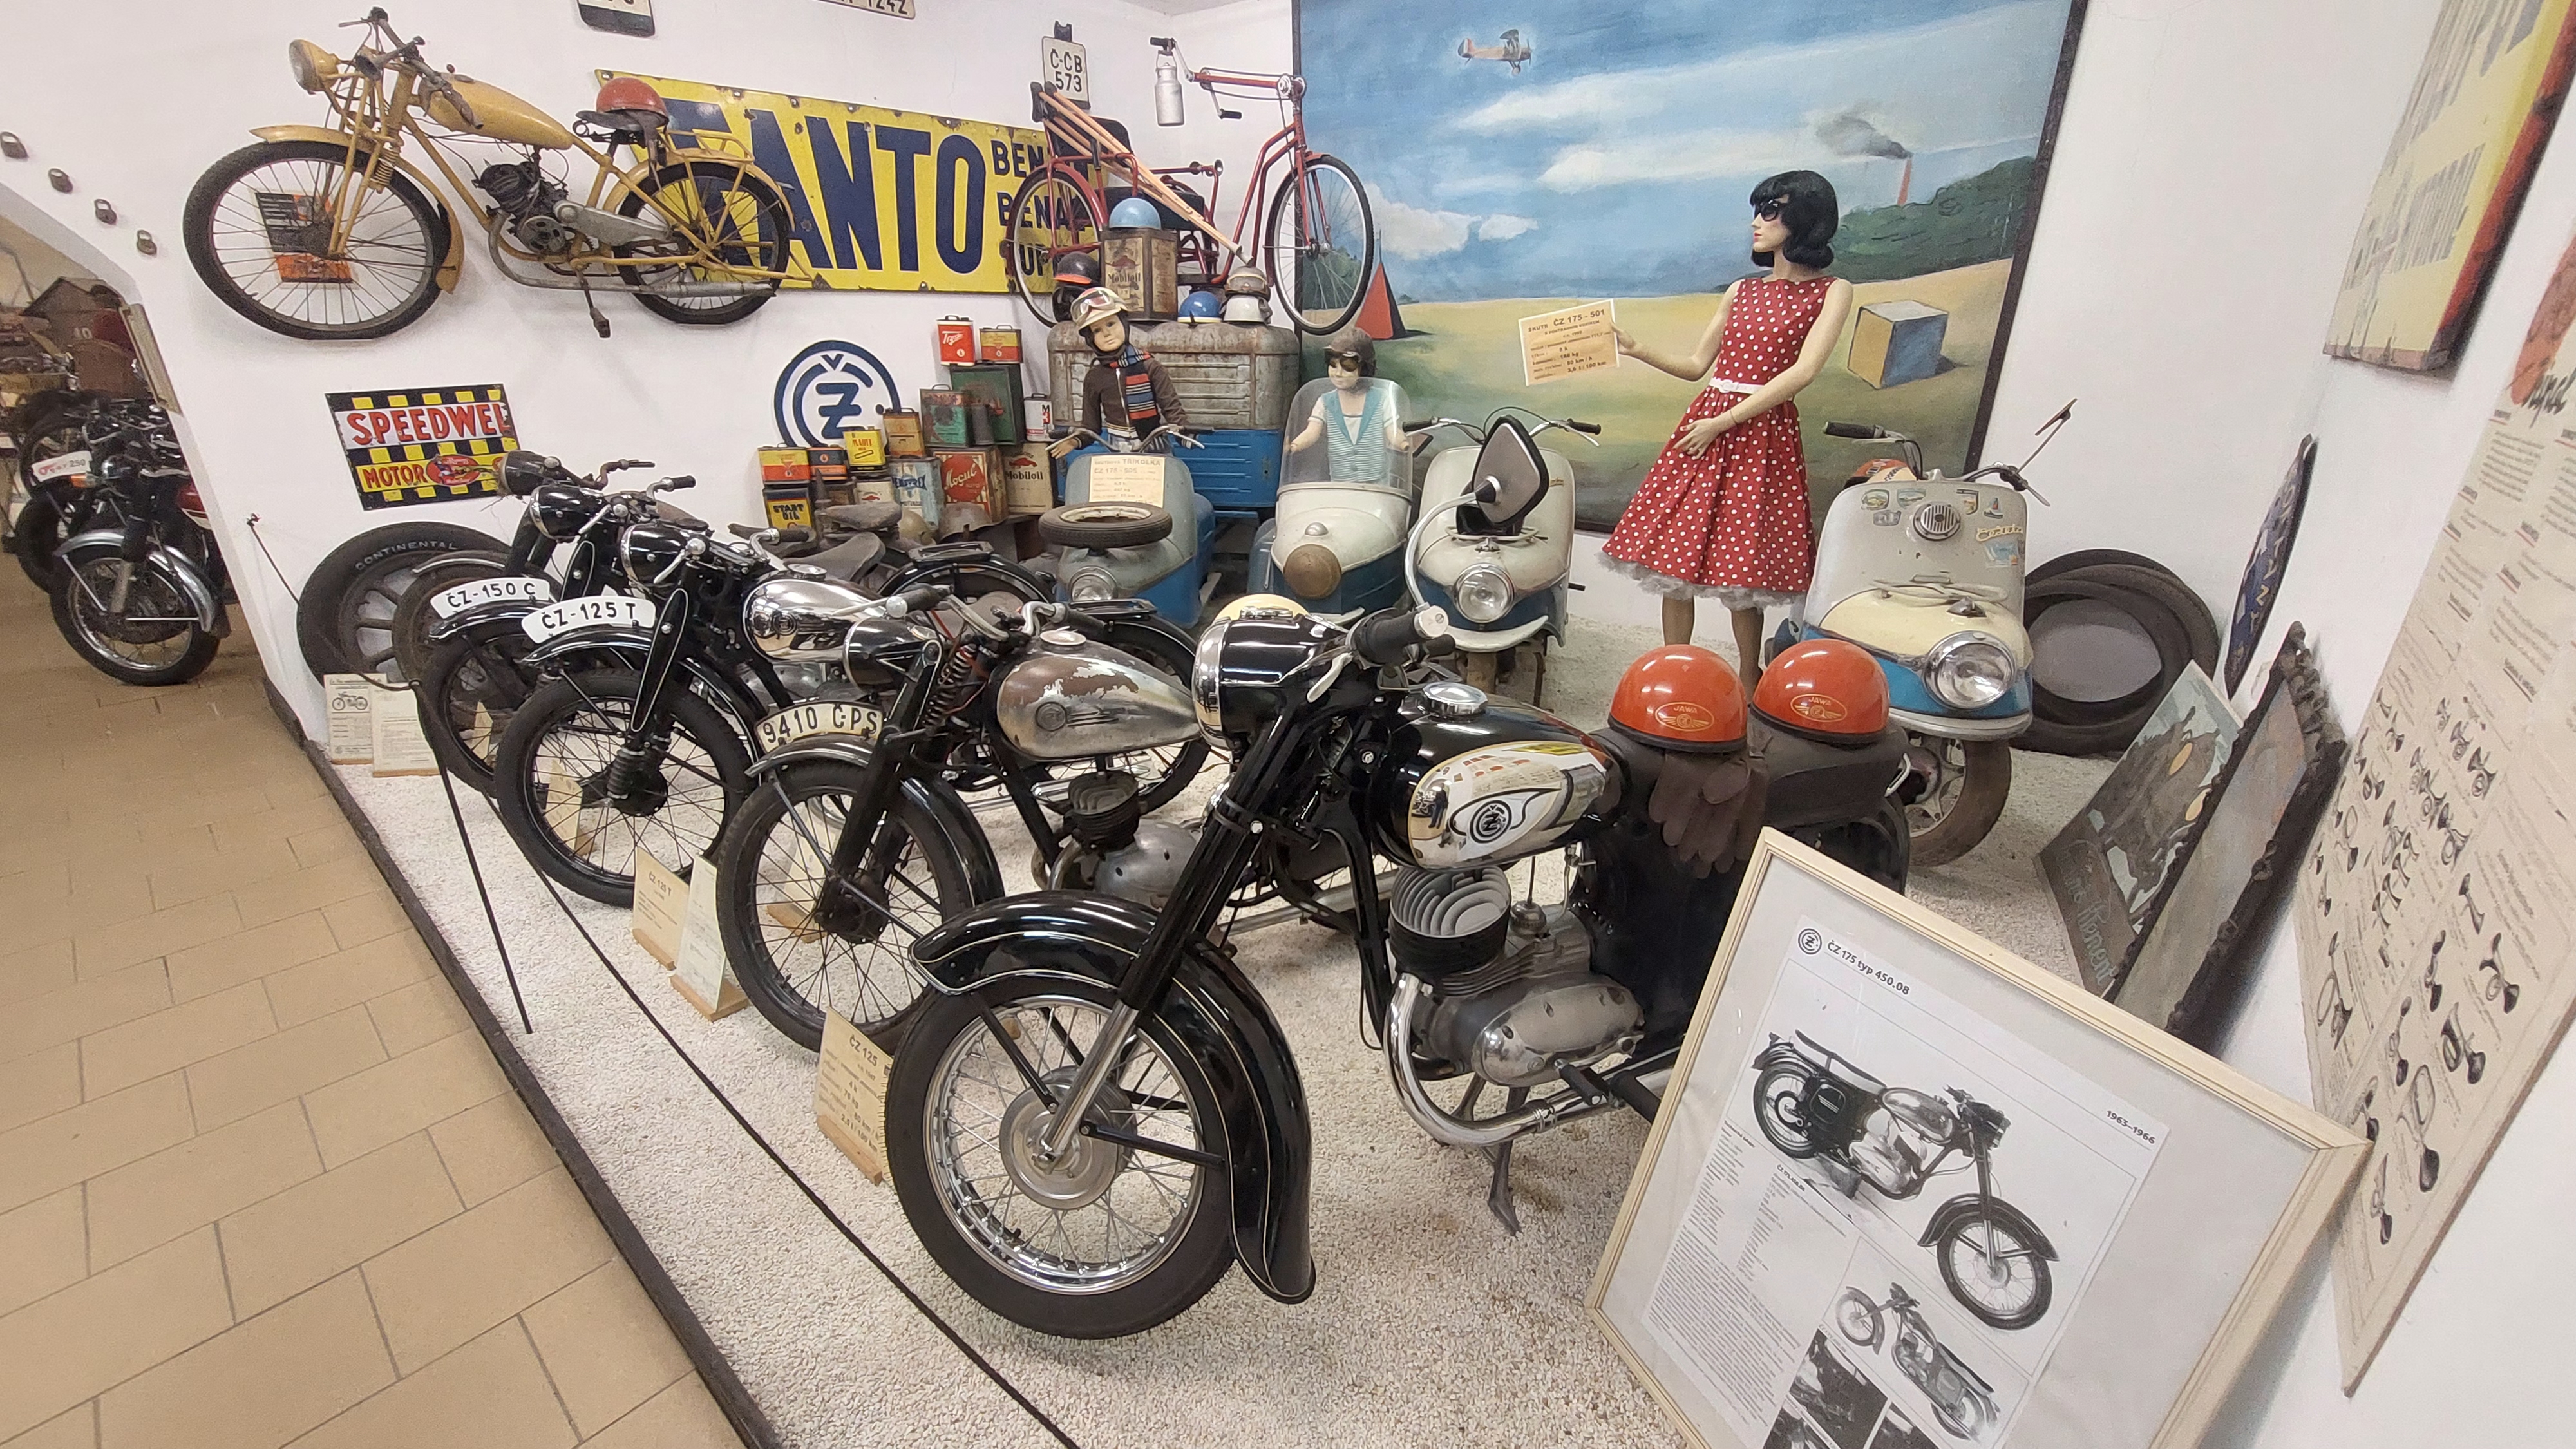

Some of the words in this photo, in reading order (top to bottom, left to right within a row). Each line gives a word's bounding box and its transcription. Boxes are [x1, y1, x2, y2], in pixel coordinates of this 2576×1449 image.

[1056, 72, 1083, 93] 573
[1567, 314, 1583, 323] 175
[1590, 309, 1605, 318] 501
[362, 464, 428, 489] MOTOR
[355, 540, 457, 571] CONTINENTAL
[447, 582, 516, 608] ČZ-150
[524, 583, 536, 596] C
[542, 601, 617, 630] ČZ-125
[626, 603, 639, 620] T
[1808, 697, 1832, 706] JAWA
[762, 707, 818, 743] 9410
[1827, 940, 1841, 955] ČZ
[1842, 950, 1857, 964] 175
[1857, 960, 1873, 975] typ
[1875, 971, 1910, 995] 450.08
[849, 1034, 861, 1052] ČZ
[862, 1047, 878, 1067] 125
